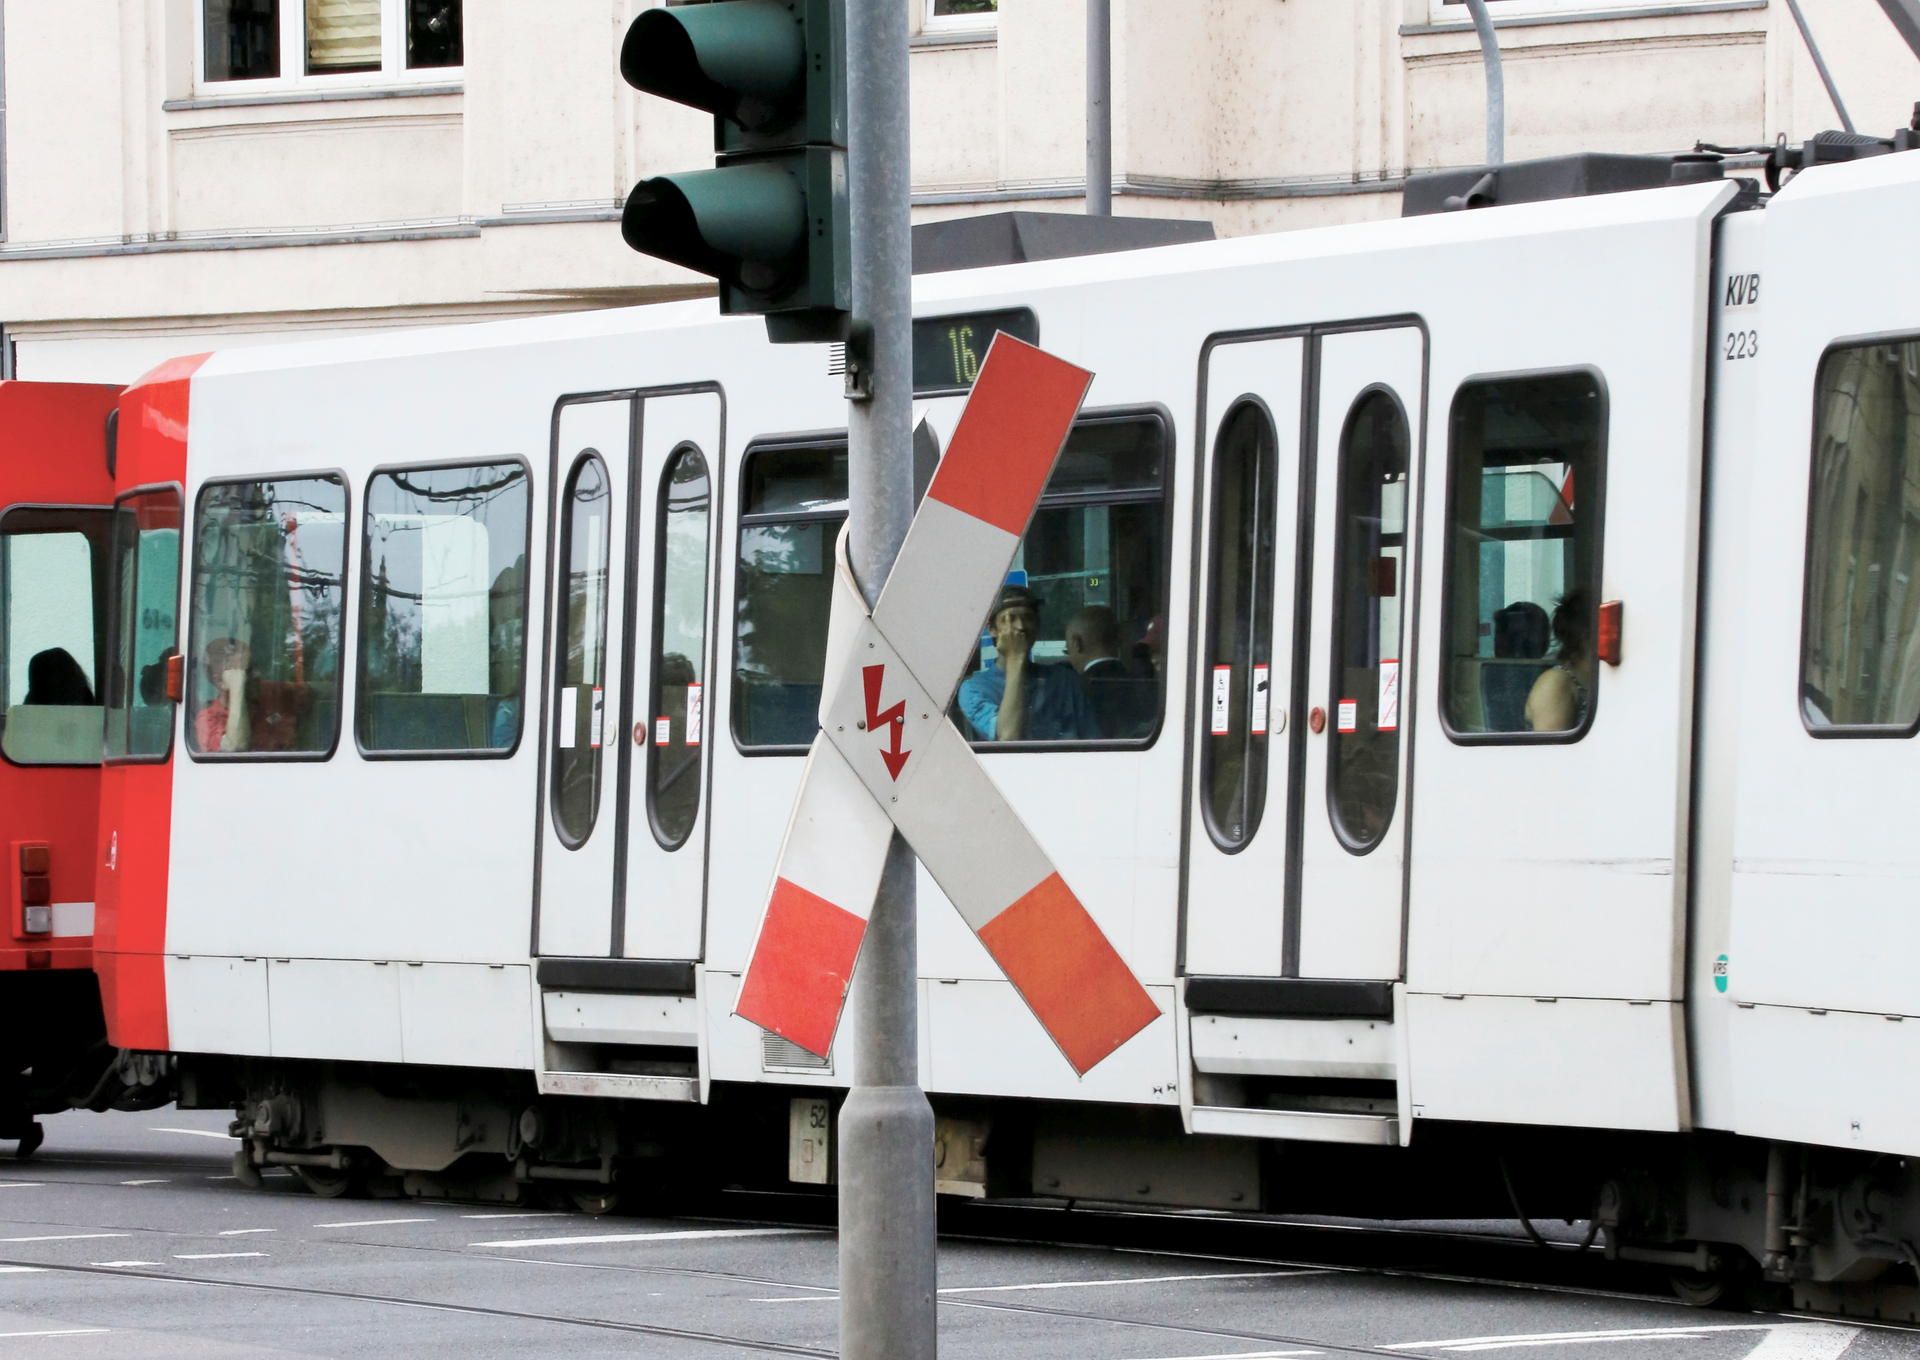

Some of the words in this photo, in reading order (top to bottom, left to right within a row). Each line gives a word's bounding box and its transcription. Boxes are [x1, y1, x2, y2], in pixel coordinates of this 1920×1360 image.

[1725, 273, 1760, 306] KVB
[948, 325, 977, 383] 16
[1726, 329, 1759, 360] 223
[810, 1104, 827, 1129] 52
